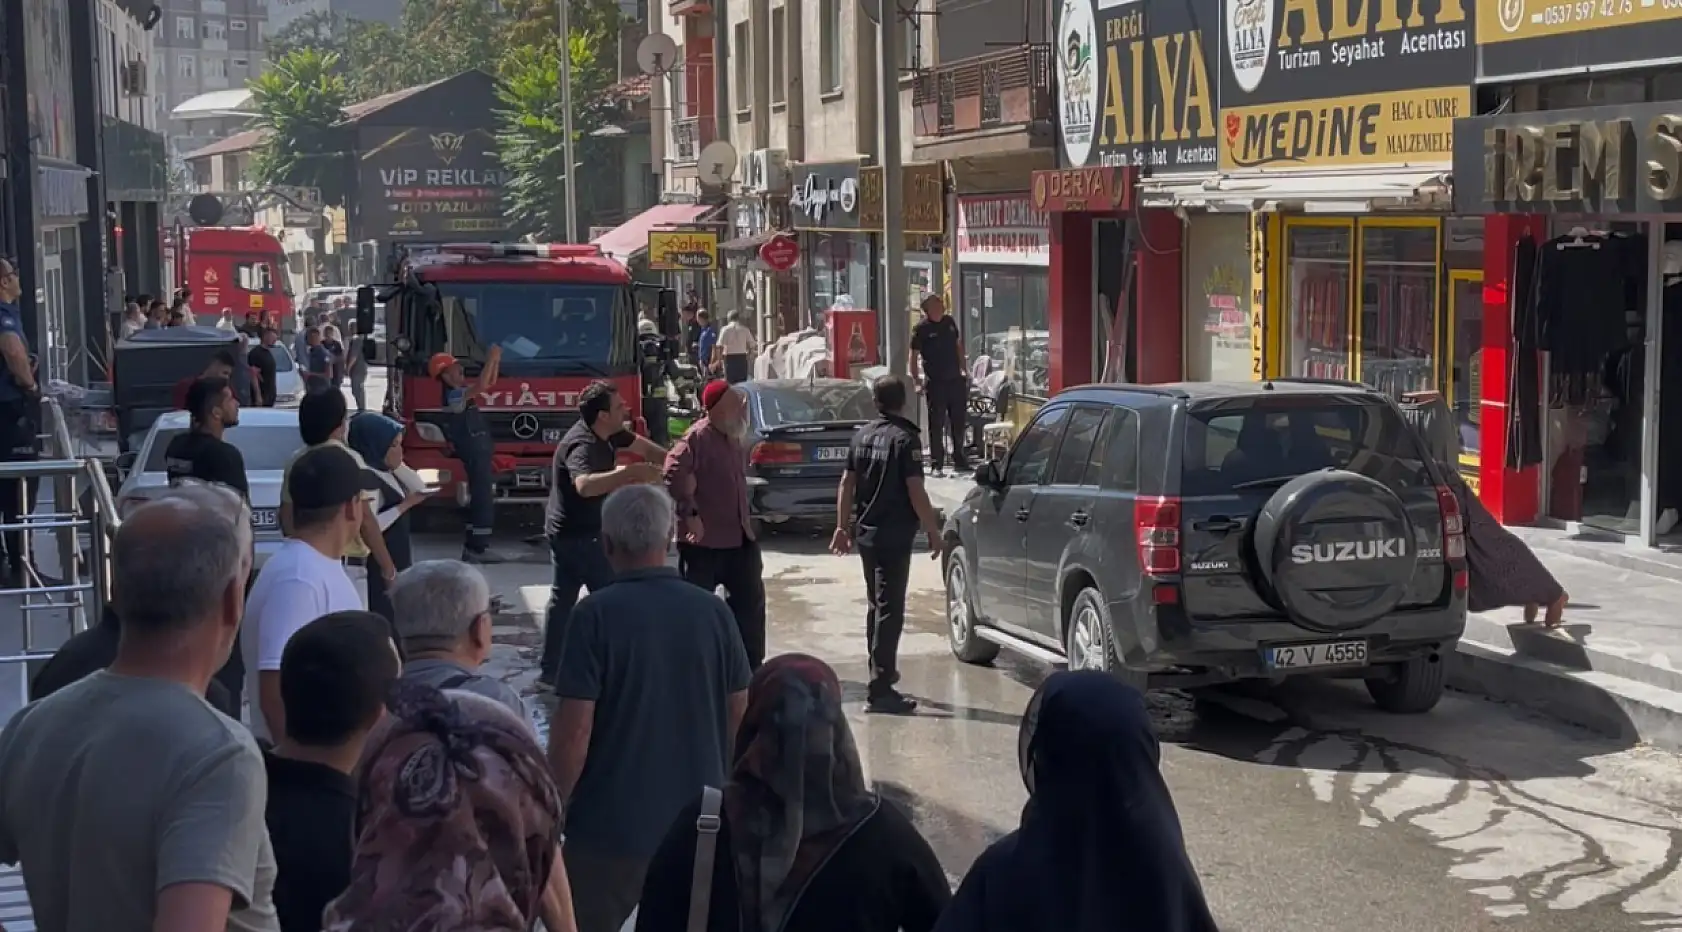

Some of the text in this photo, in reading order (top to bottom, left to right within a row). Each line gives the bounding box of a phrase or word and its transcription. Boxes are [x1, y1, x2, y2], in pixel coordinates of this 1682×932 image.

[1544, 6, 1573, 25] 0537
[1576, 1, 1596, 20] 597
[1278, 29, 1466, 70] Turizm Seyahat Acentası
[1392, 101, 1414, 121] HAC
[1426, 98, 1459, 119] UMRE
[1243, 103, 1381, 160] MEDİNE
[1386, 132, 1453, 154] MALZEMELE
[1099, 151, 1127, 167] Turizm
[380, 165, 418, 186] VİP
[1051, 170, 1104, 197] DERYA
[401, 202, 432, 213] OTO
[1291, 538, 1405, 565] SUZUKI
[1191, 561, 1228, 569] SUZUKI
[1275, 644, 1365, 666] 42 V 4556
